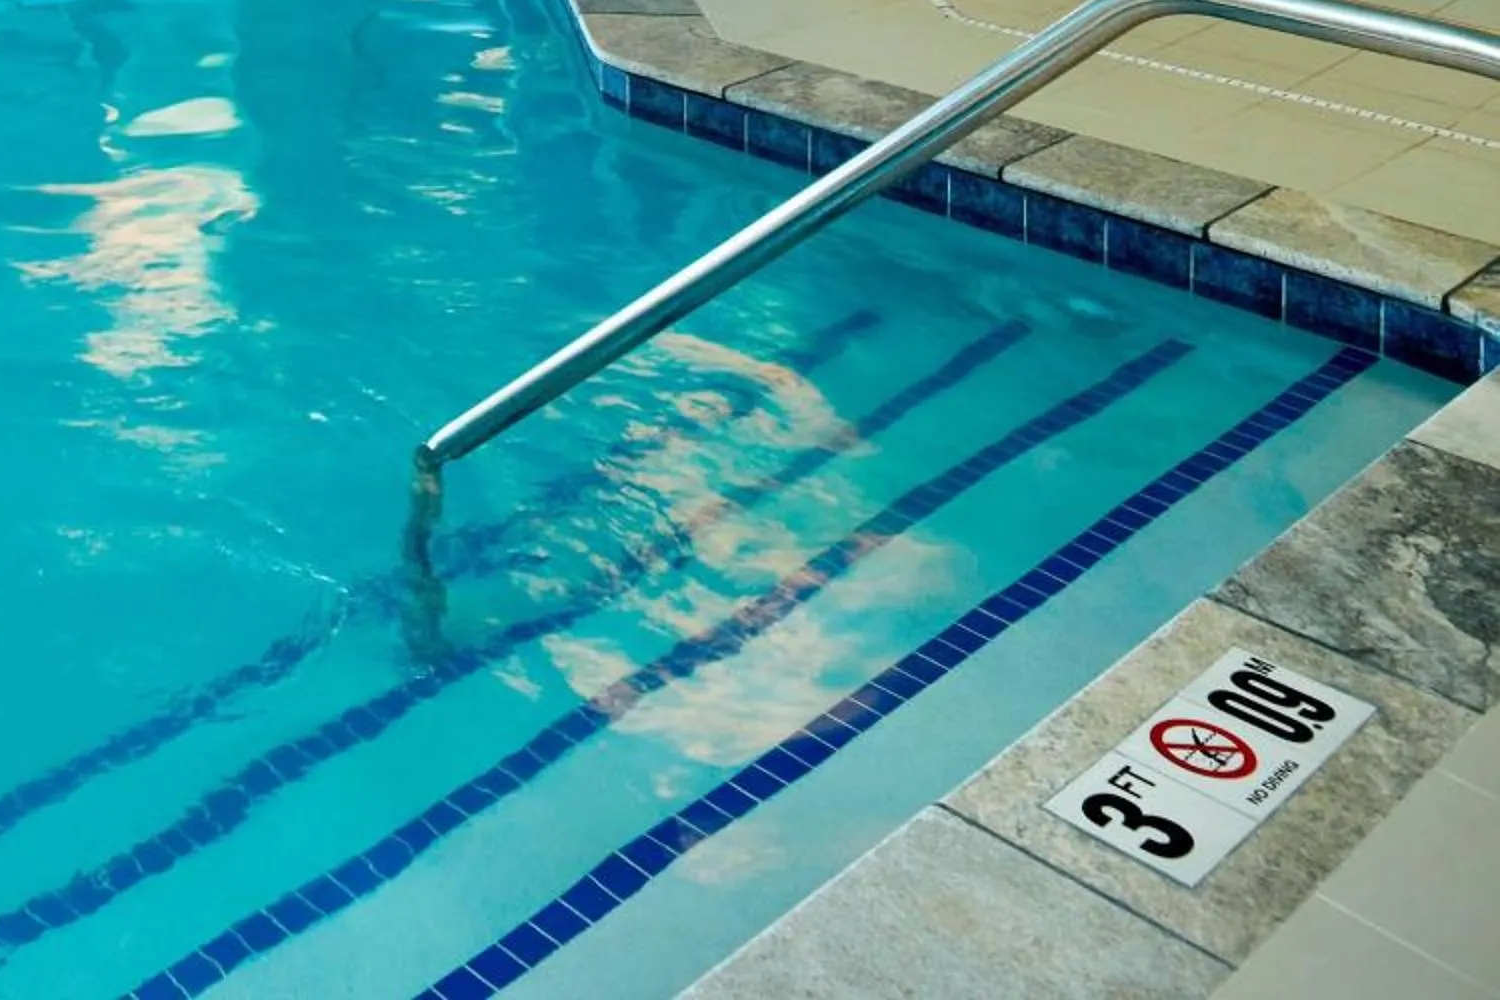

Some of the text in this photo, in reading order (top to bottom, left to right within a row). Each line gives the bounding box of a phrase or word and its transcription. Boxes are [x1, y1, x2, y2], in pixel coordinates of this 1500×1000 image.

[1207, 670, 1336, 744] 0.9
[1082, 765, 1195, 859] 3 FT
[1246, 760, 1300, 806] NO DIVING
